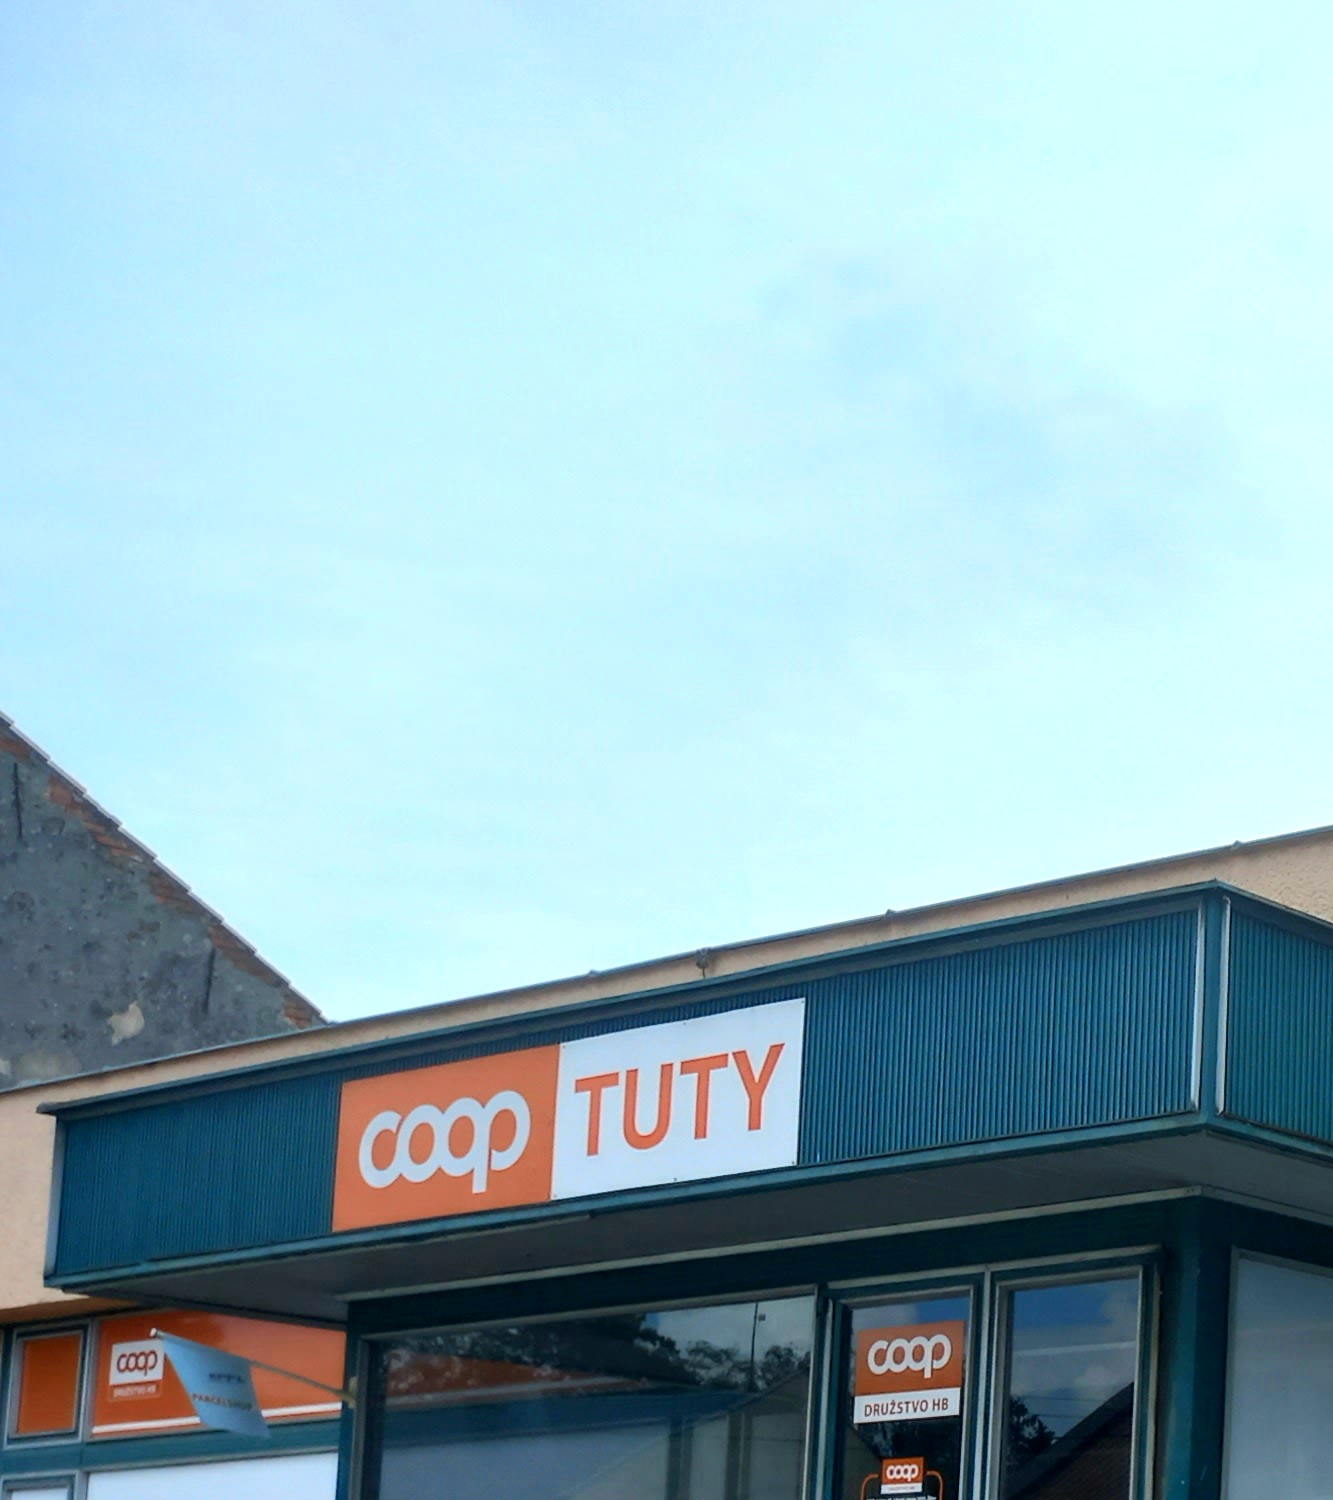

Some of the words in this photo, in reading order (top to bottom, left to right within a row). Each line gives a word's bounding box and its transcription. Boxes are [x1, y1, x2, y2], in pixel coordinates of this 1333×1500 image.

[574, 1043, 786, 1157] TUTY
[864, 1400, 928, 1418] DRUŽSTVO
[932, 1397, 949, 1412] HB
